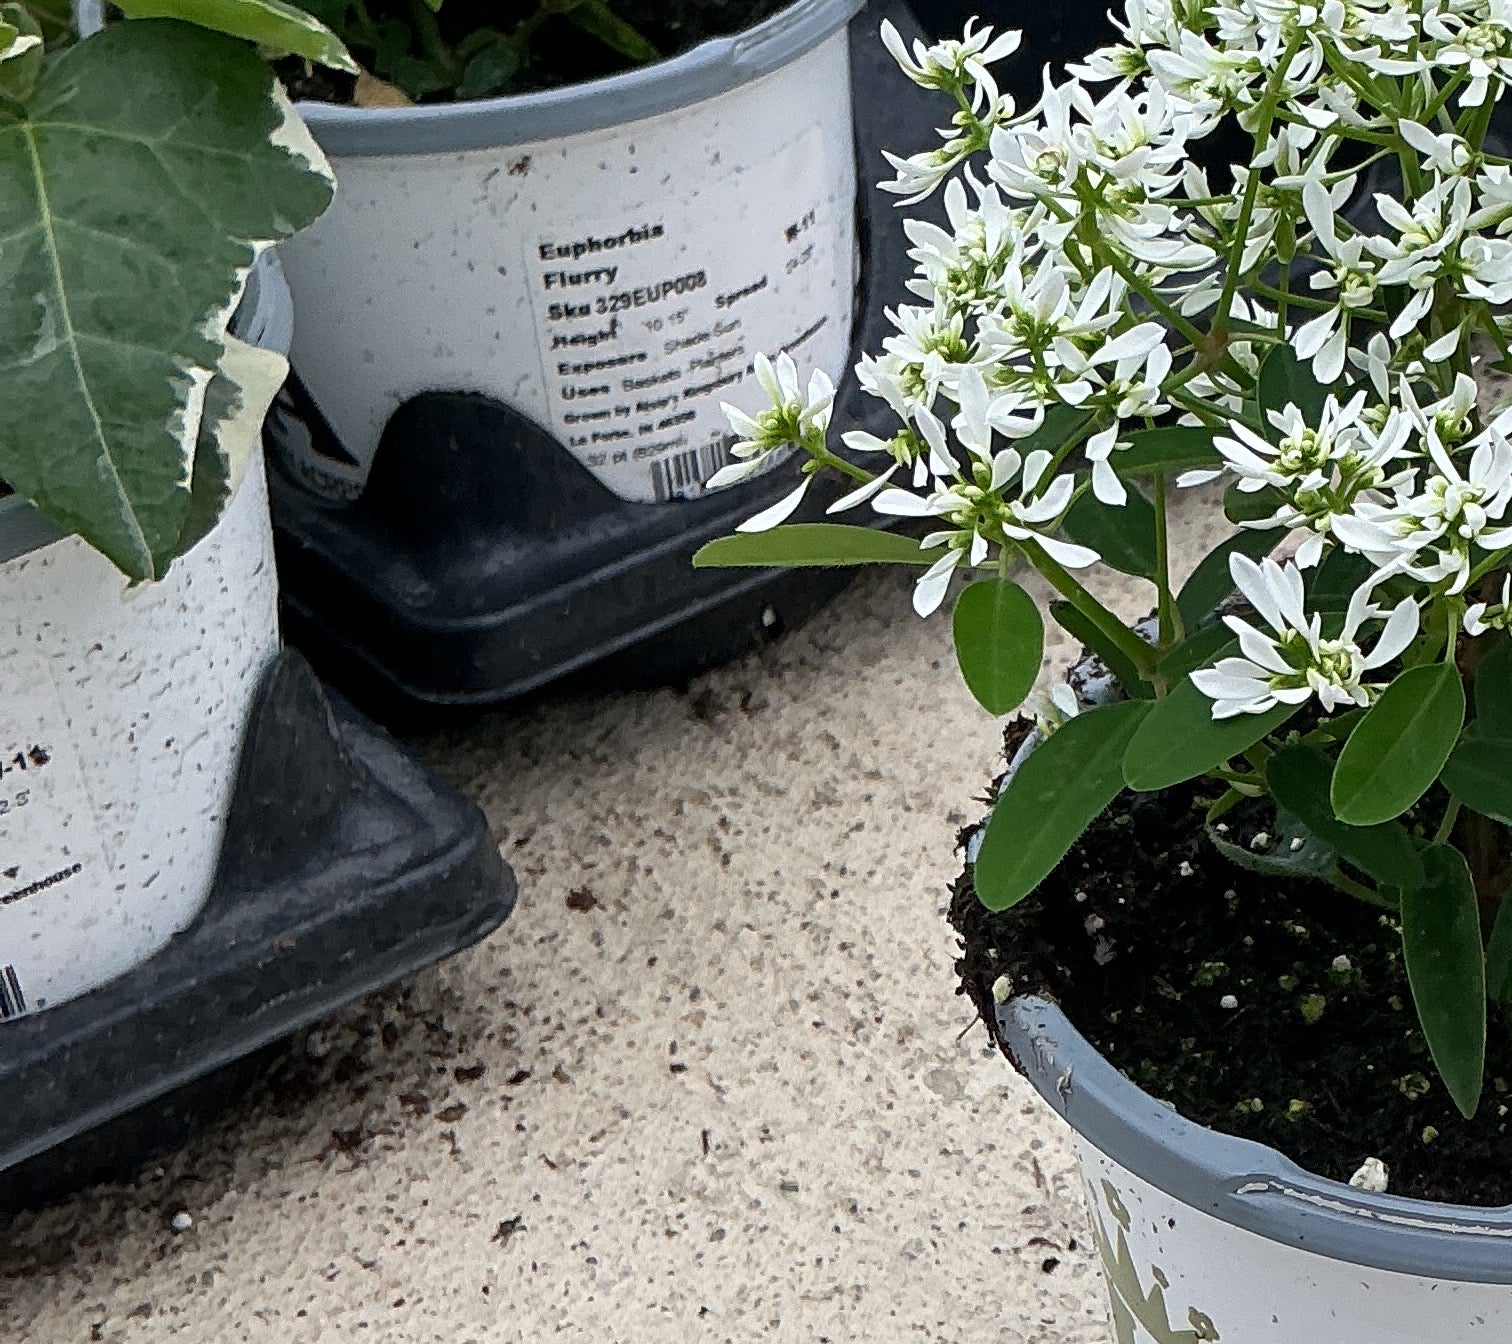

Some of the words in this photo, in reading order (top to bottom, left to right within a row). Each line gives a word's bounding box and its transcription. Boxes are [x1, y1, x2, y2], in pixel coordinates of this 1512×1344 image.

[539, 224, 664, 260] Euphorbia
[543, 266, 618, 290] Flurry
[548, 303, 591, 321] Sku
[595, 269, 708, 315] 329EUP008
[562, 384, 610, 400] Uses
